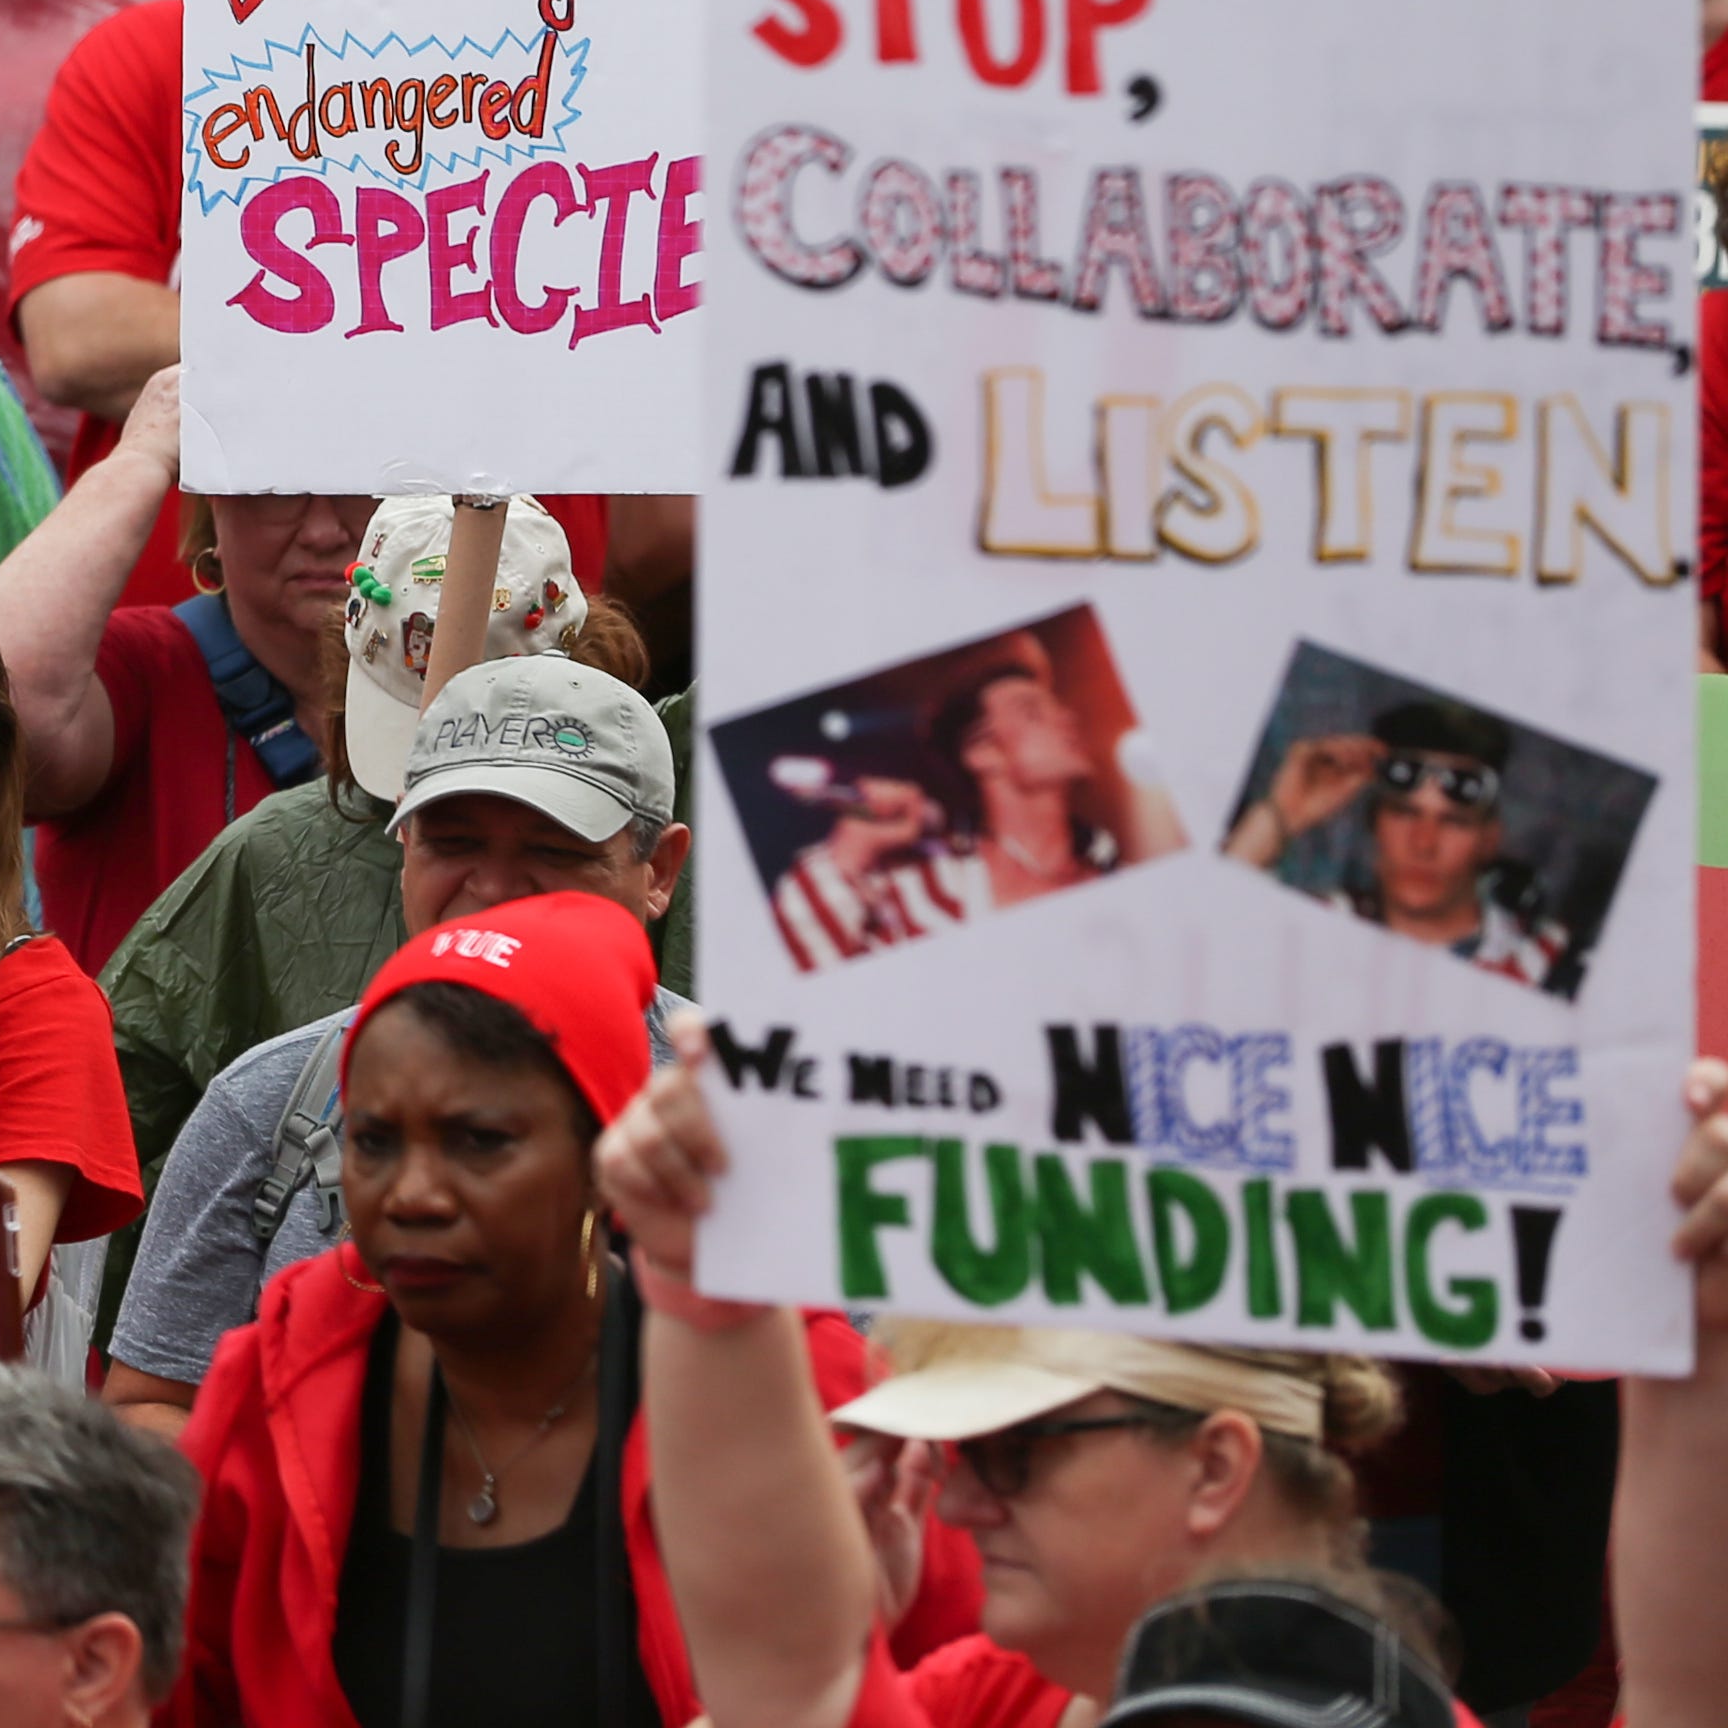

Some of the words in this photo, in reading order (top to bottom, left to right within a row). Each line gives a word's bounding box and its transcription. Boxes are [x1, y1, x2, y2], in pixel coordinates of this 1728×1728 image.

[202, 30, 558, 175] endangered
[732, 119, 1696, 379] COLLABORATE,
[728, 361, 935, 491] AND
[846, 1054, 1005, 1115] NEED
[1044, 1024, 1298, 1176] NICE
[1319, 1032, 1590, 1195] NICE
[831, 1134, 1564, 1350] FUNDING!
